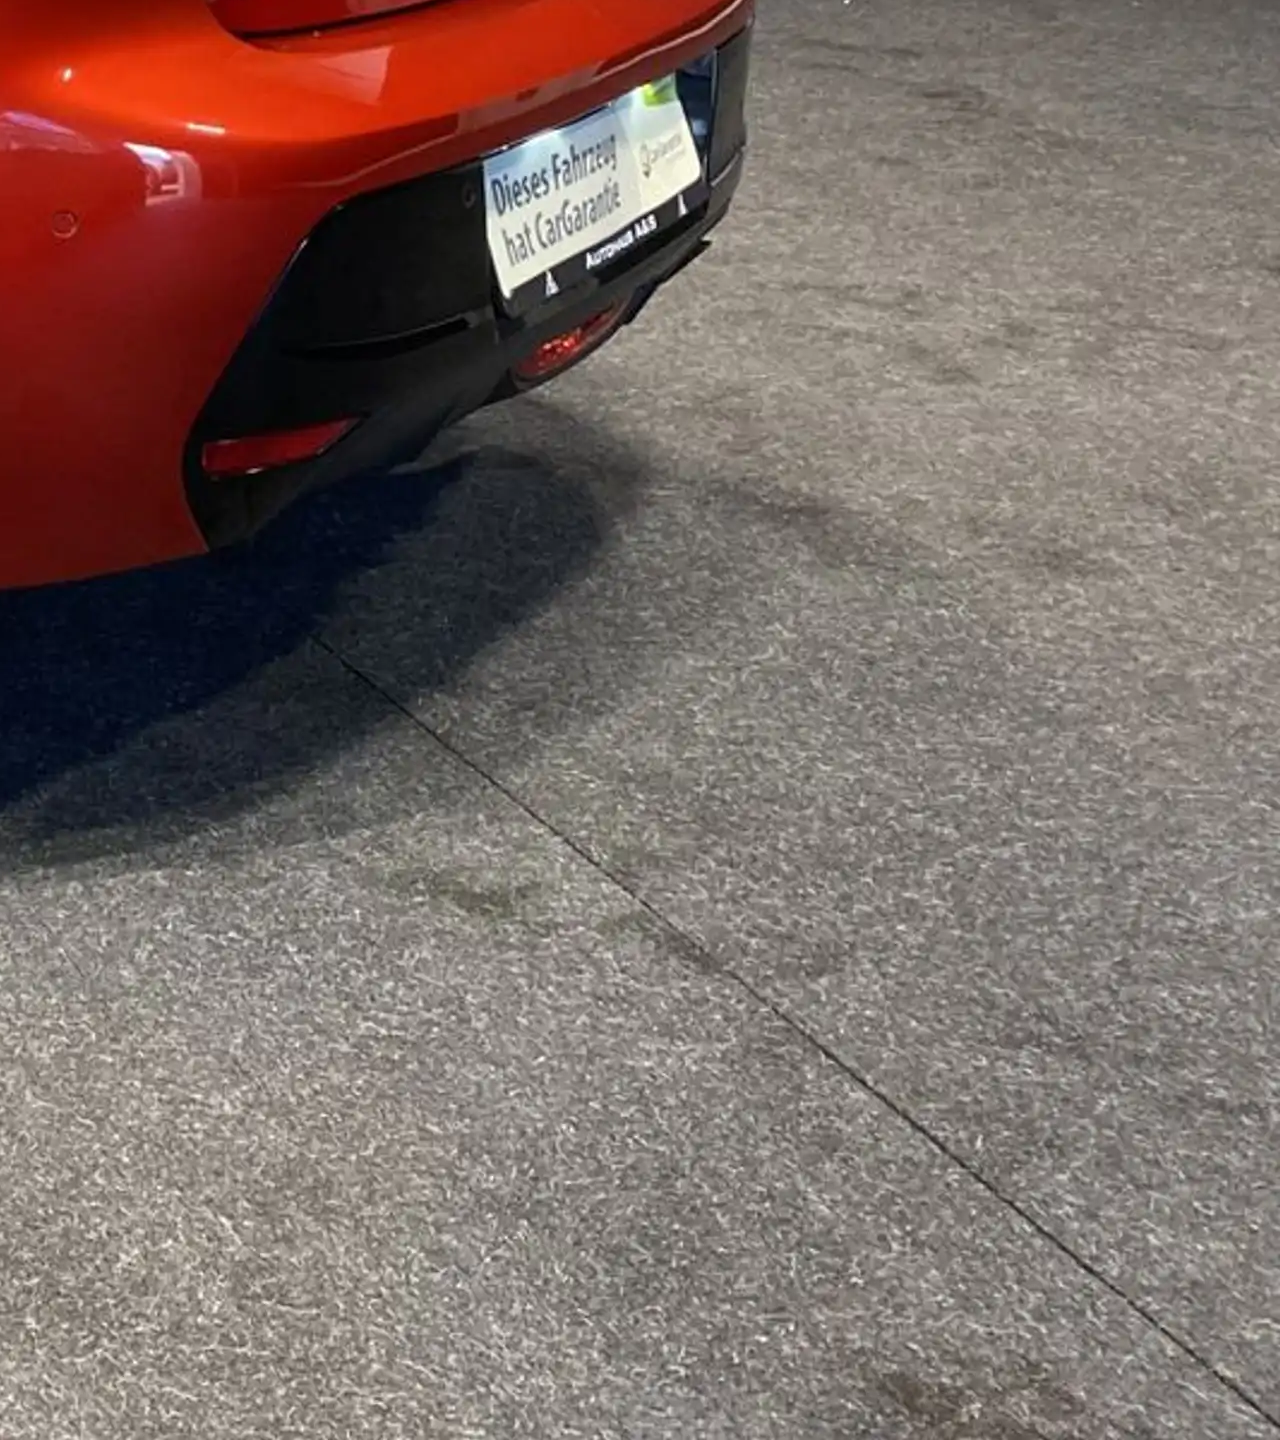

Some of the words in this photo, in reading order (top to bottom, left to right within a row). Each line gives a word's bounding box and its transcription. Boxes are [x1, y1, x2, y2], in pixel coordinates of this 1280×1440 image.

[491, 166, 550, 217] Dieses
[550, 134, 618, 191] Fahrzeug
[502, 225, 536, 267] hat
[534, 177, 622, 250] CarGarantie
